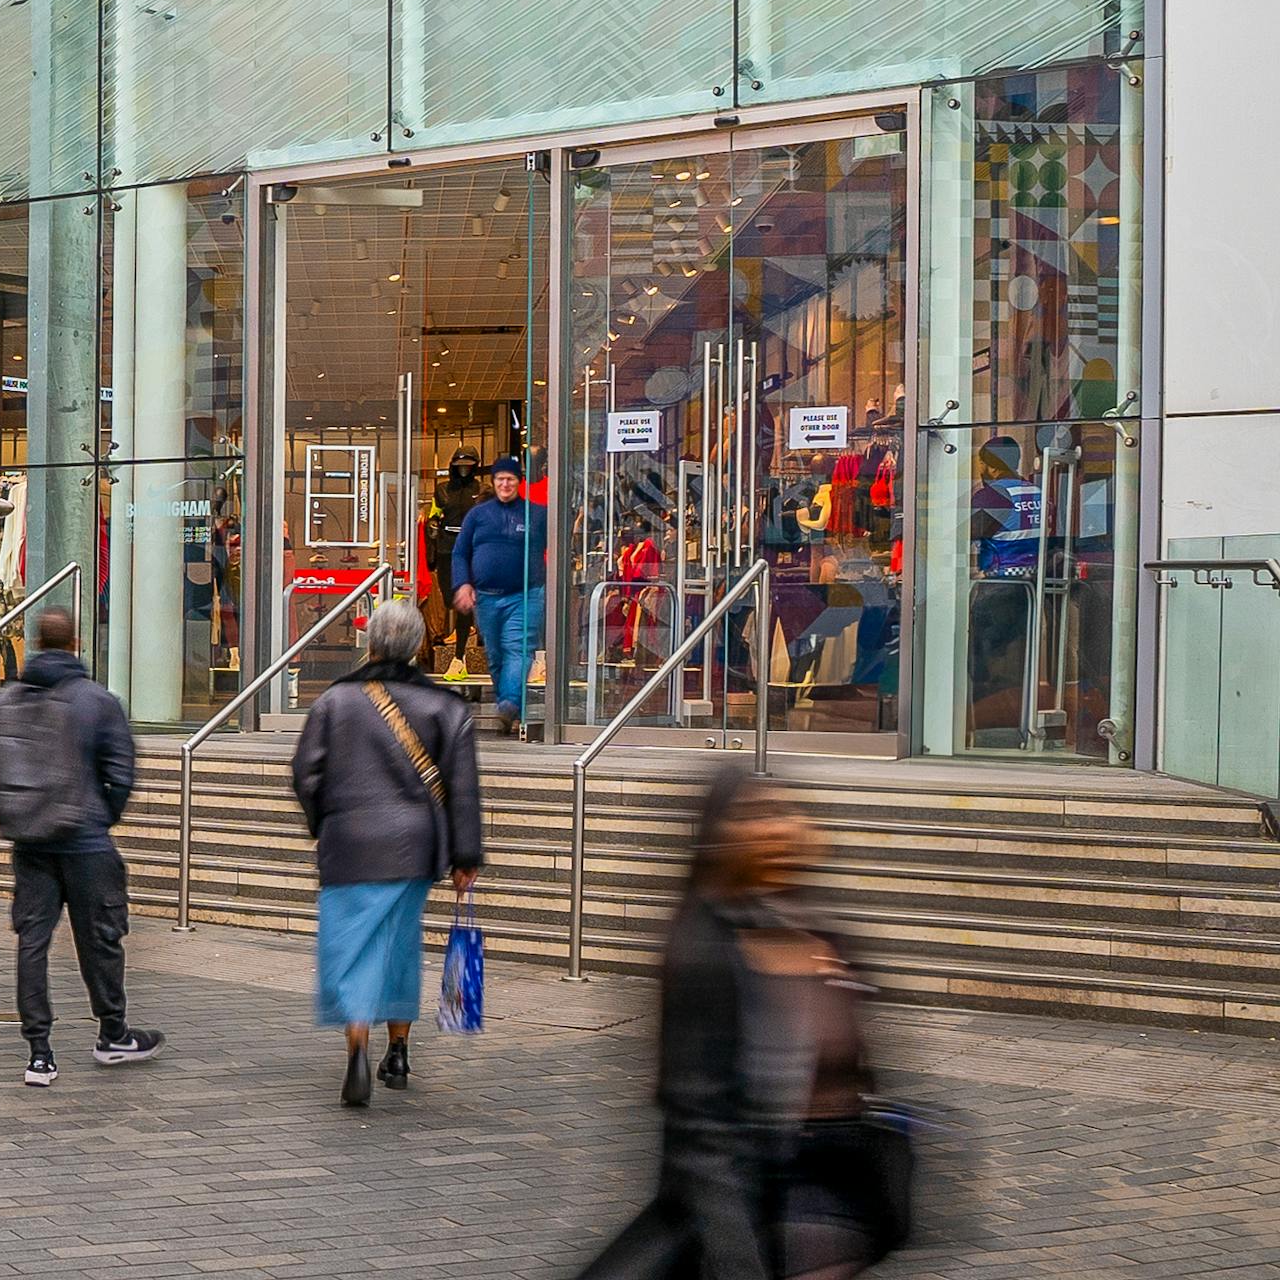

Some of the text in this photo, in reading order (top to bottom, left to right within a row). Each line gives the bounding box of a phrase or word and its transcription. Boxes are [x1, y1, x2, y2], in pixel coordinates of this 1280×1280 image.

[802, 414, 825, 422] PLEASE
[821, 423, 840, 431] DOOR
[360, 453, 368, 523] STORE DIRECTORY
[126, 500, 211, 517] BINGHAM
[1014, 501, 1041, 512] SECU
[1027, 514, 1041, 525] TE
